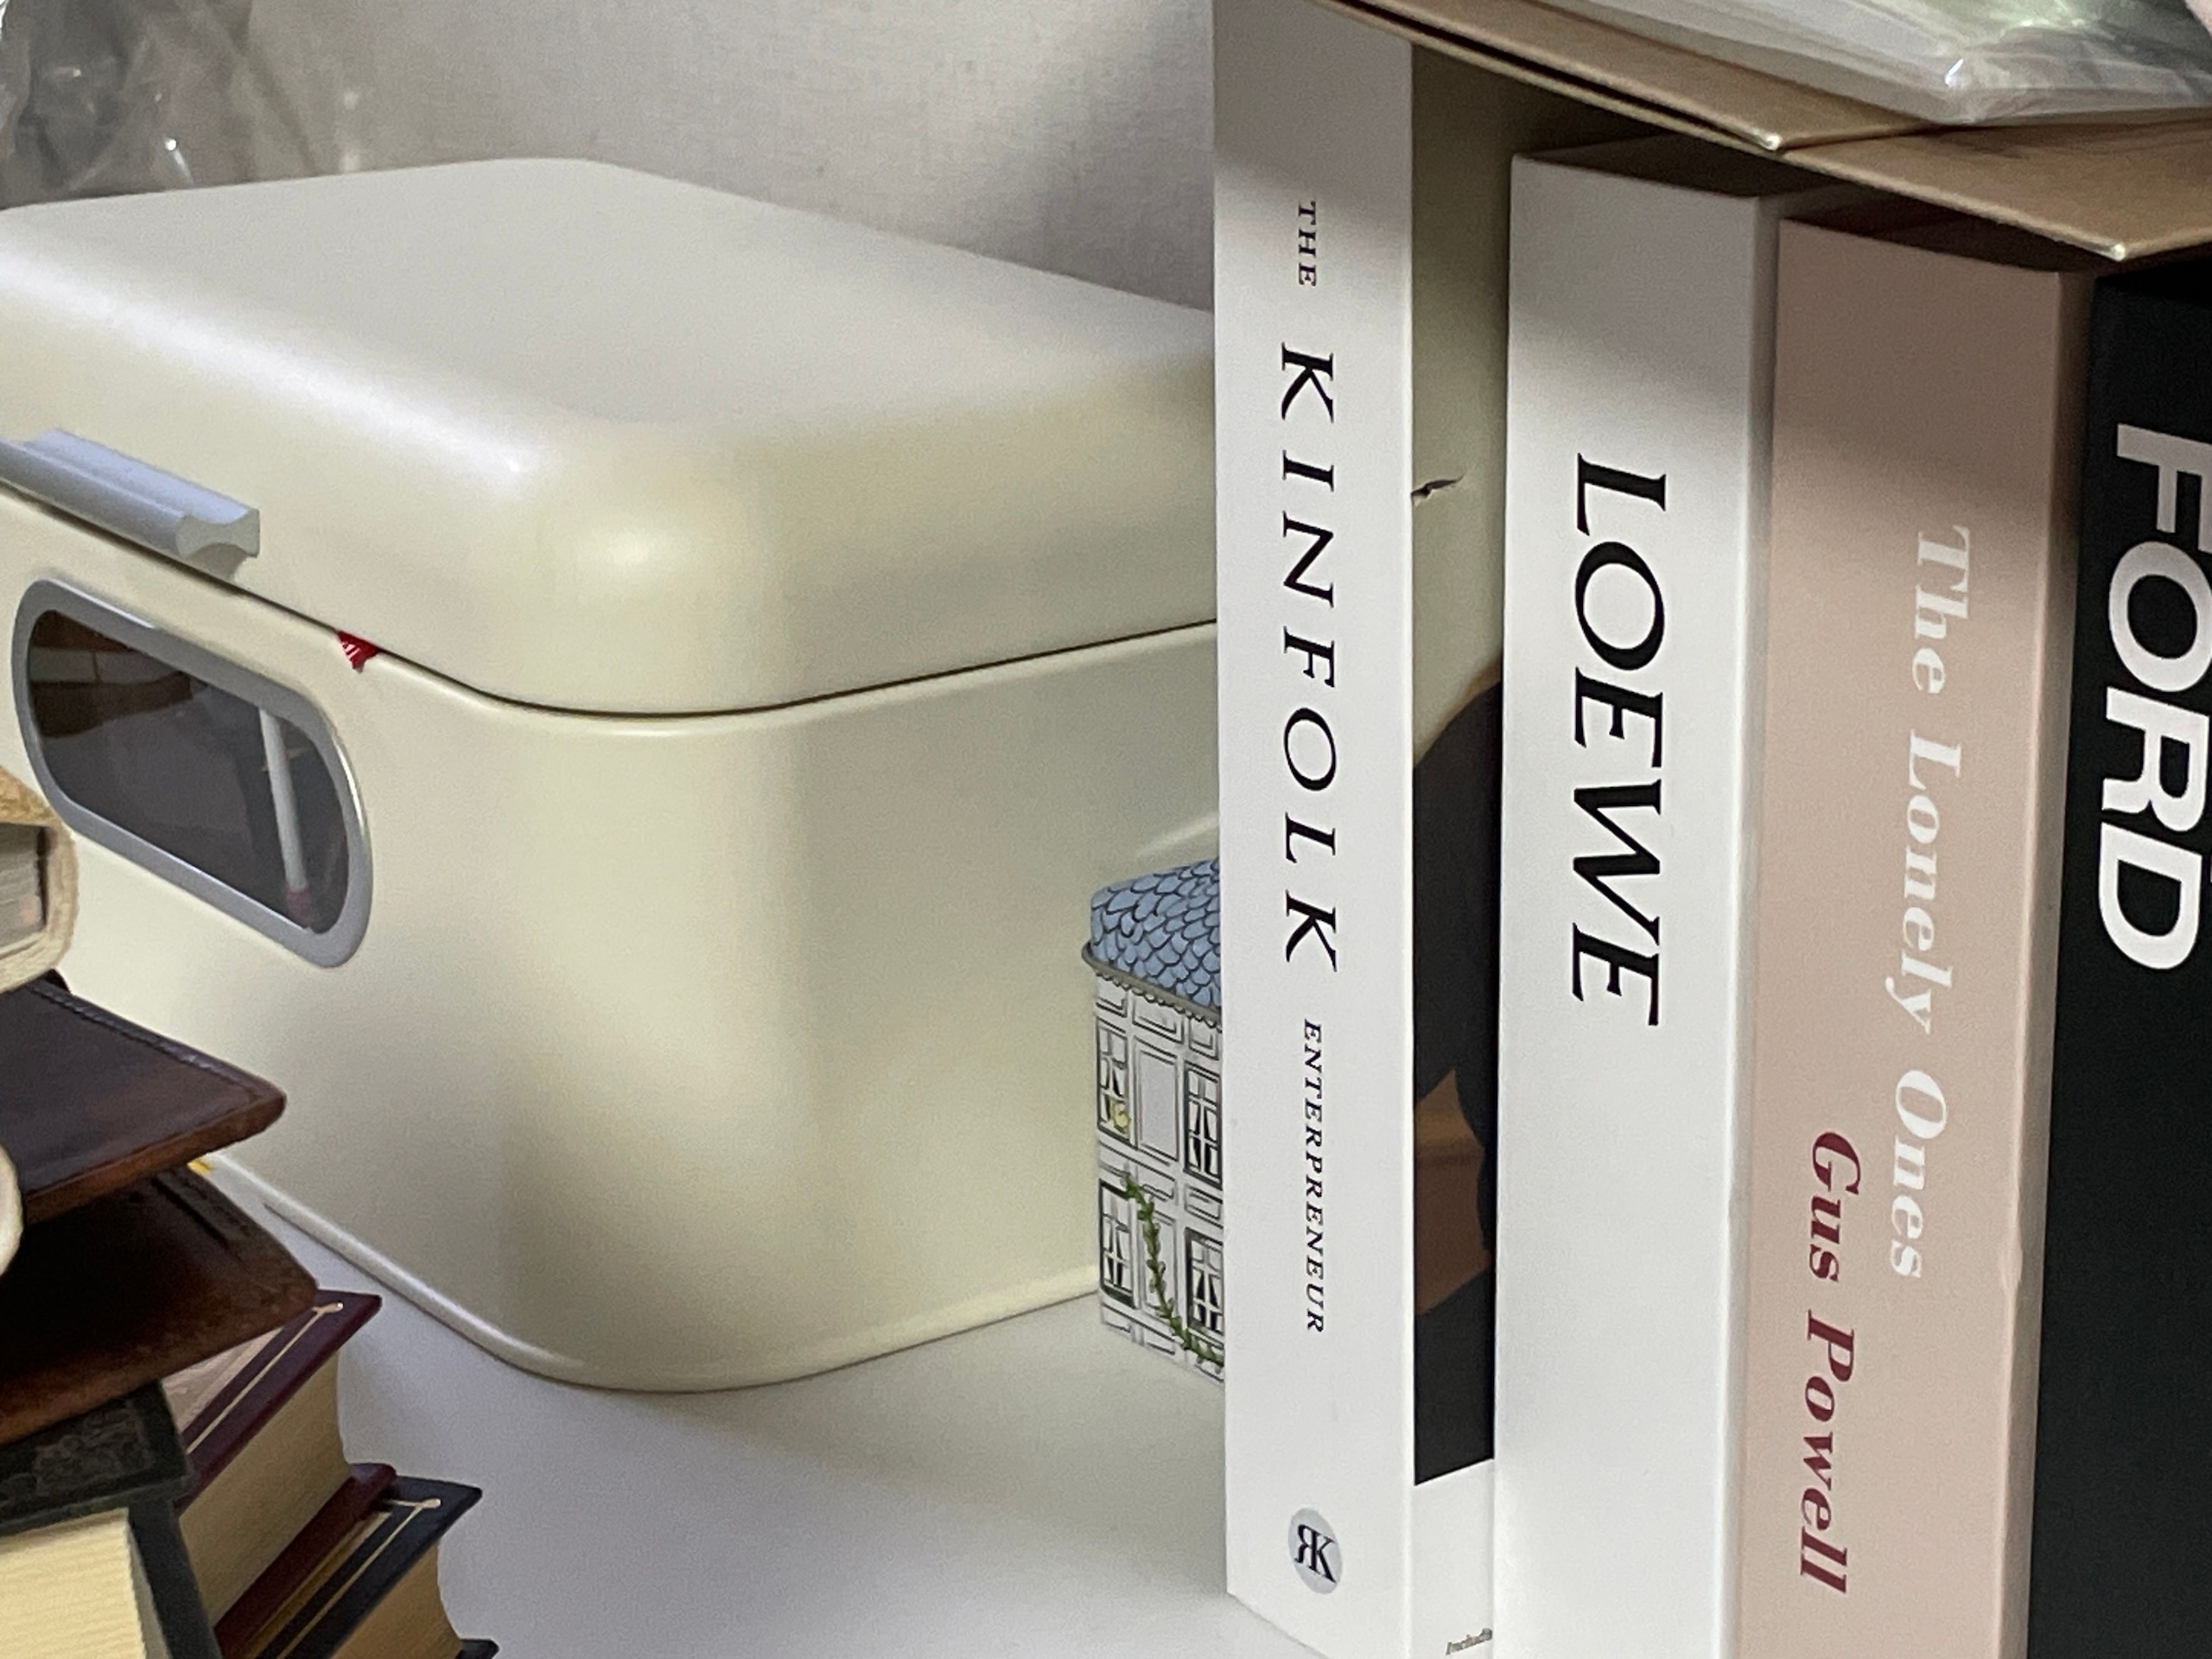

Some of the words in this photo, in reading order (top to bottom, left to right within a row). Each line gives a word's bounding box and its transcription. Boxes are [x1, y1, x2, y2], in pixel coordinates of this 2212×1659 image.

[1298, 200, 1317, 288] THE
[1281, 342, 1338, 973] KINFOLK
[1572, 452, 1667, 1027] LOEWE
[1911, 524, 1971, 694] The
[2097, 423, 2212, 970] FORD
[1885, 728, 1962, 1035] Lonely
[1303, 1018, 1325, 1333] ENTERPRENEUR
[1809, 1131, 1862, 1282] Gus
[1890, 1069, 1948, 1280] Ones
[1800, 1309, 1855, 1595] Powell
